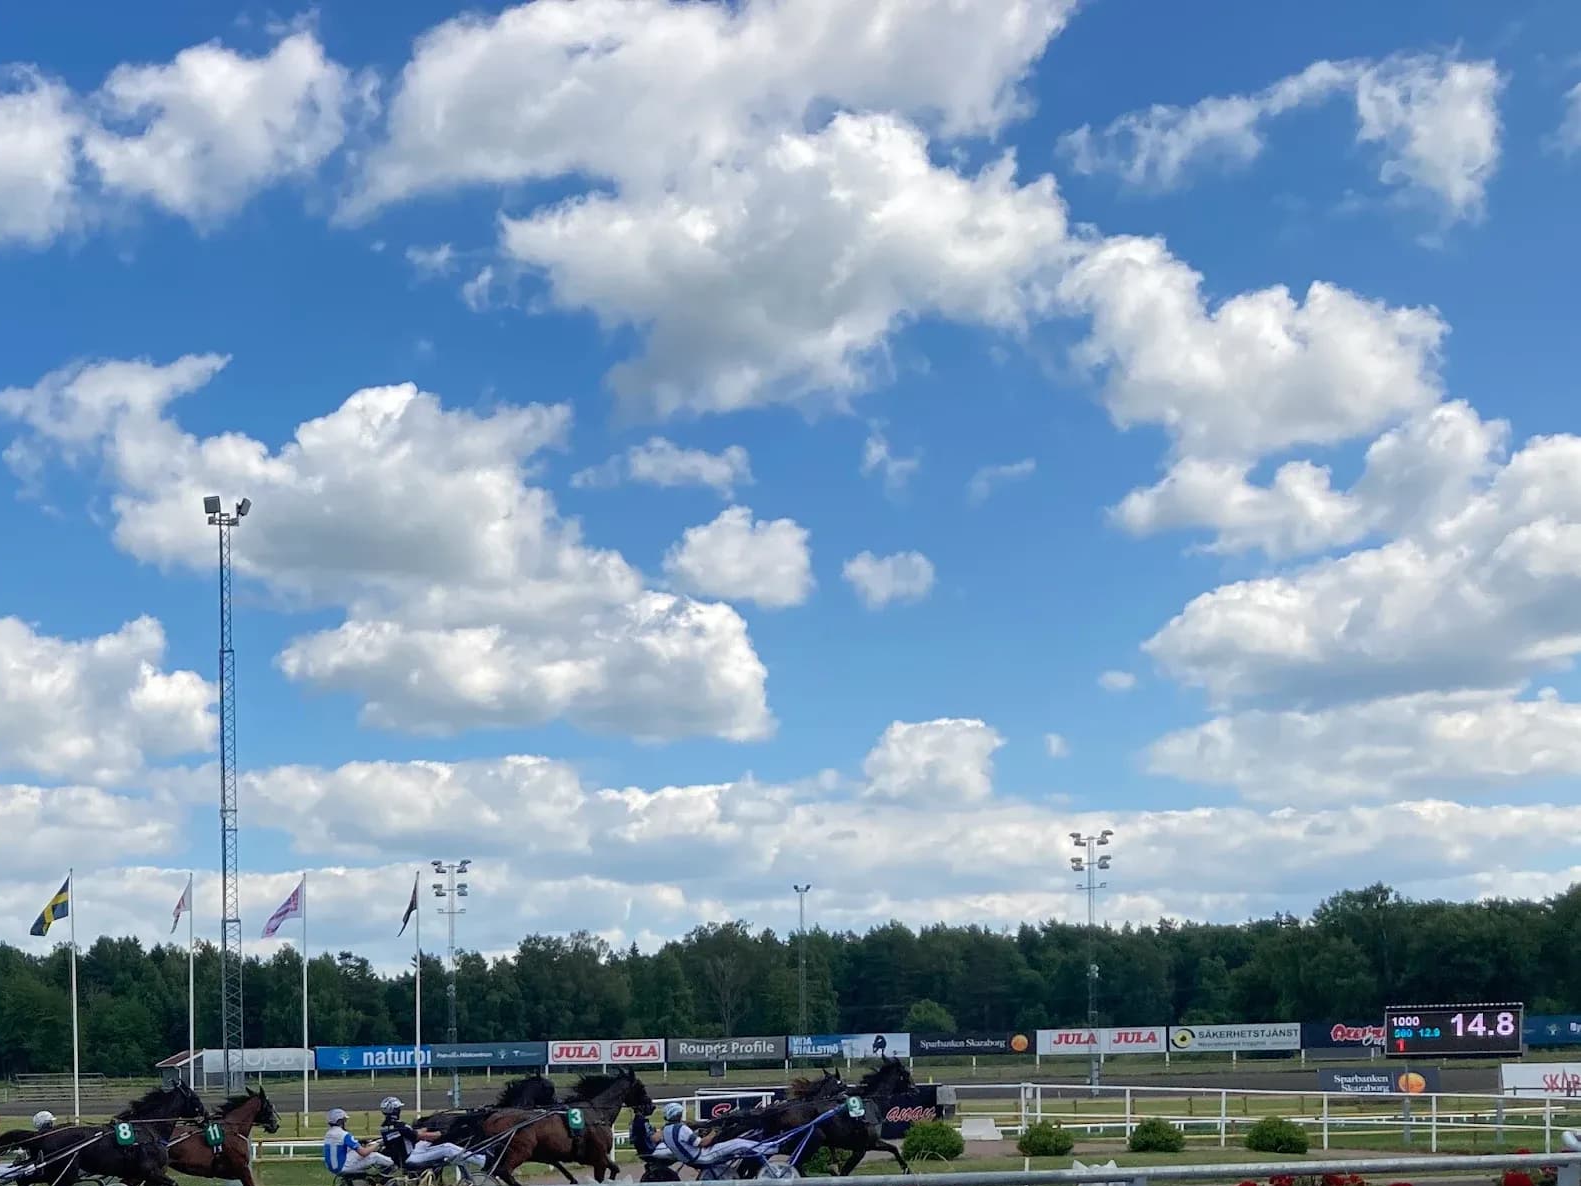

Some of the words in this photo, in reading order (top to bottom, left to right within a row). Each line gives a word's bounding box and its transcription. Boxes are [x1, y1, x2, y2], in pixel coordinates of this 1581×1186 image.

[1391, 1015, 1420, 1027] 1000
[1450, 1012, 1515, 1037] 14.8
[920, 1039, 965, 1050] Sparbanken
[966, 1038, 1007, 1049] Skaraborg
[1053, 1031, 1098, 1045] JULA
[1112, 1031, 1158, 1045] JULA
[554, 1045, 600, 1059] JULA
[613, 1044, 658, 1058] JULA
[731, 1040, 775, 1053] Profile
[1333, 1073, 1389, 1084] Sparbanken
[1340, 1082, 1390, 1093] Skaraborg
[848, 1096, 861, 1112] 9
[571, 1108, 583, 1123] 3
[118, 1122, 132, 1140] 8
[207, 1123, 222, 1140] 11
